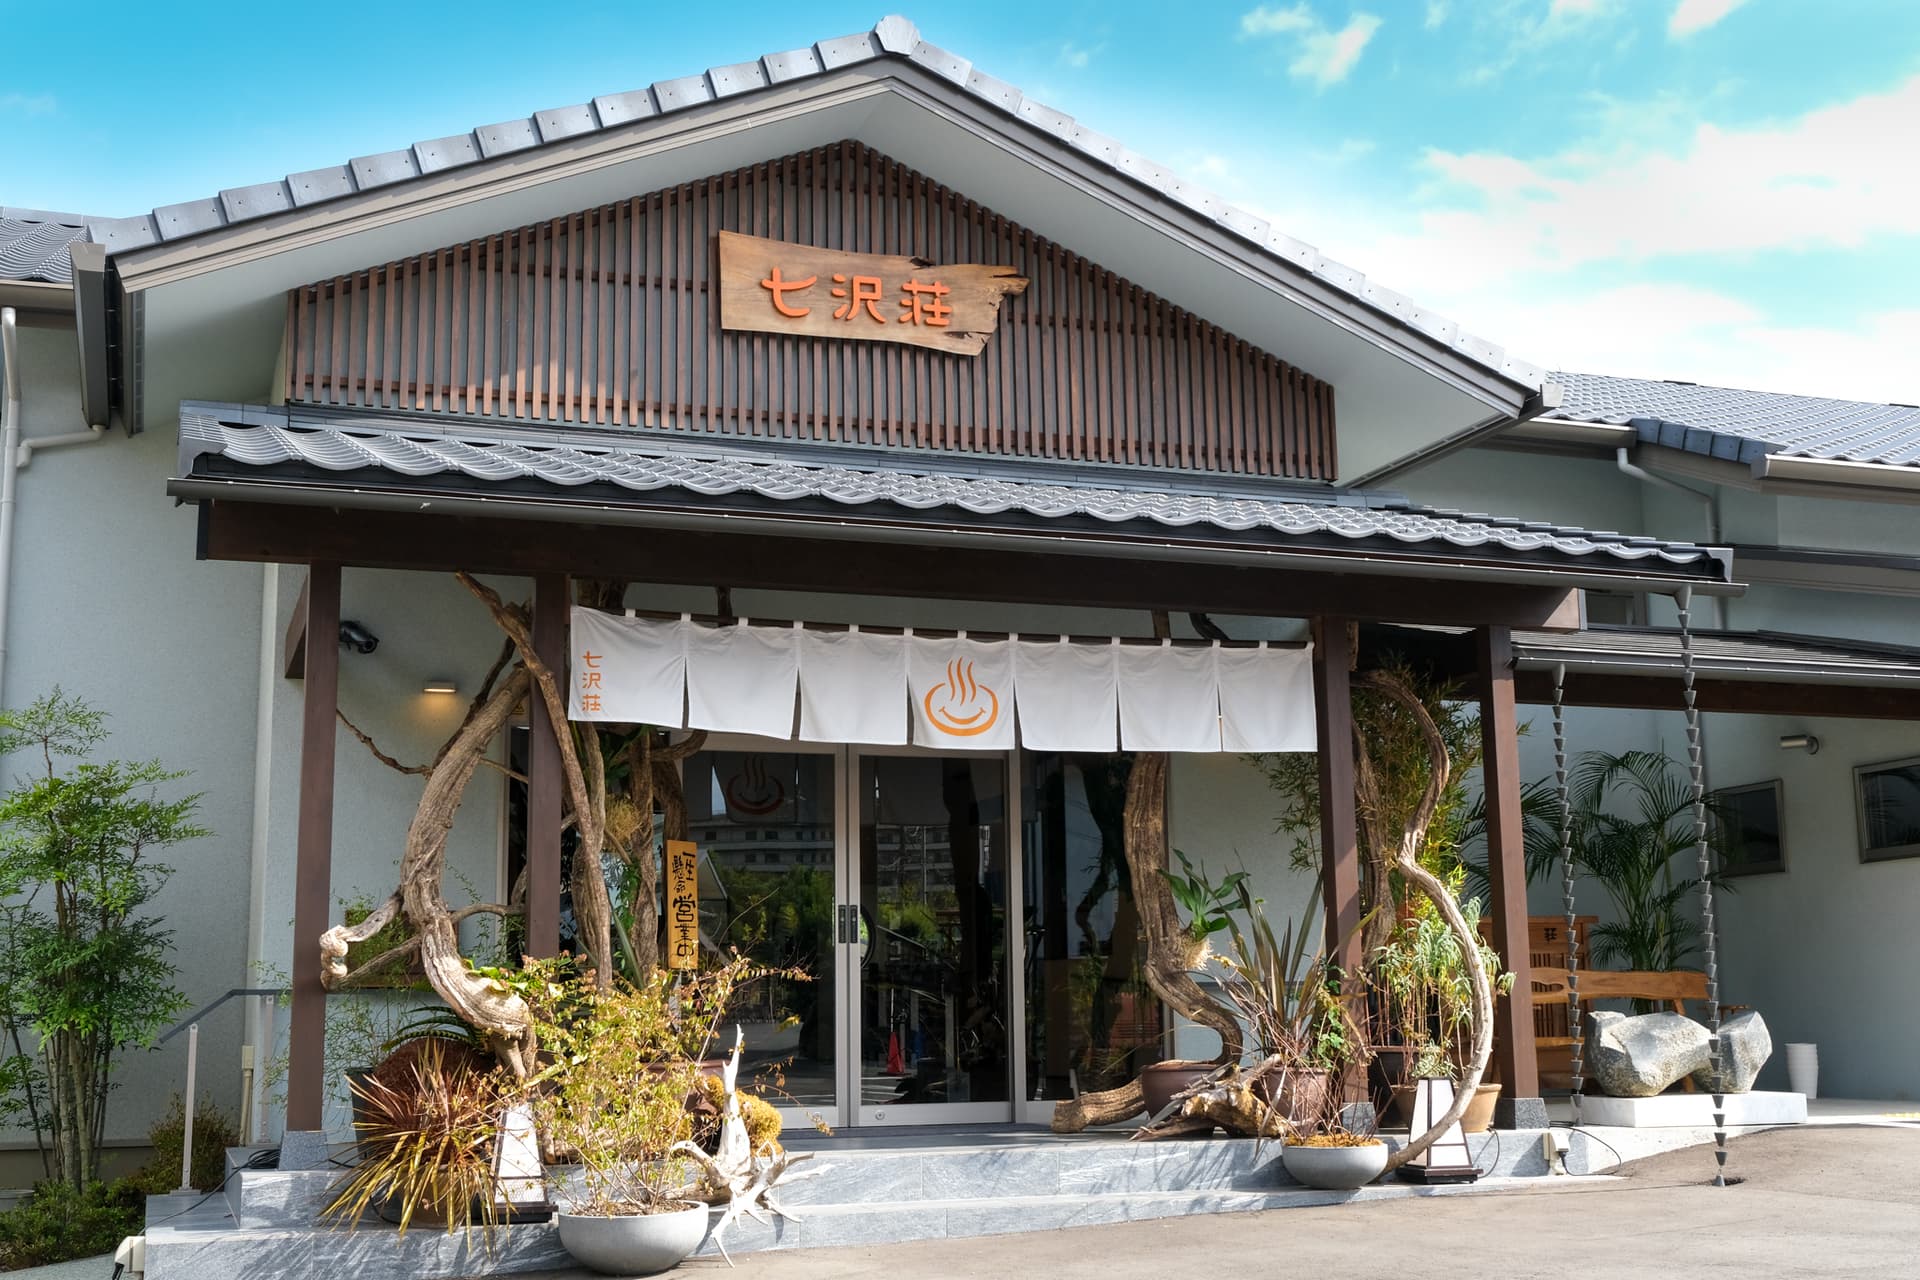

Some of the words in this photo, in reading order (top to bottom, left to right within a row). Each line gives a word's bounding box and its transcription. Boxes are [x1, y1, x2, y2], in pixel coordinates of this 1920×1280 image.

[760, 266, 953, 327] 七沢荘
[581, 650, 603, 712] 七沢荘
